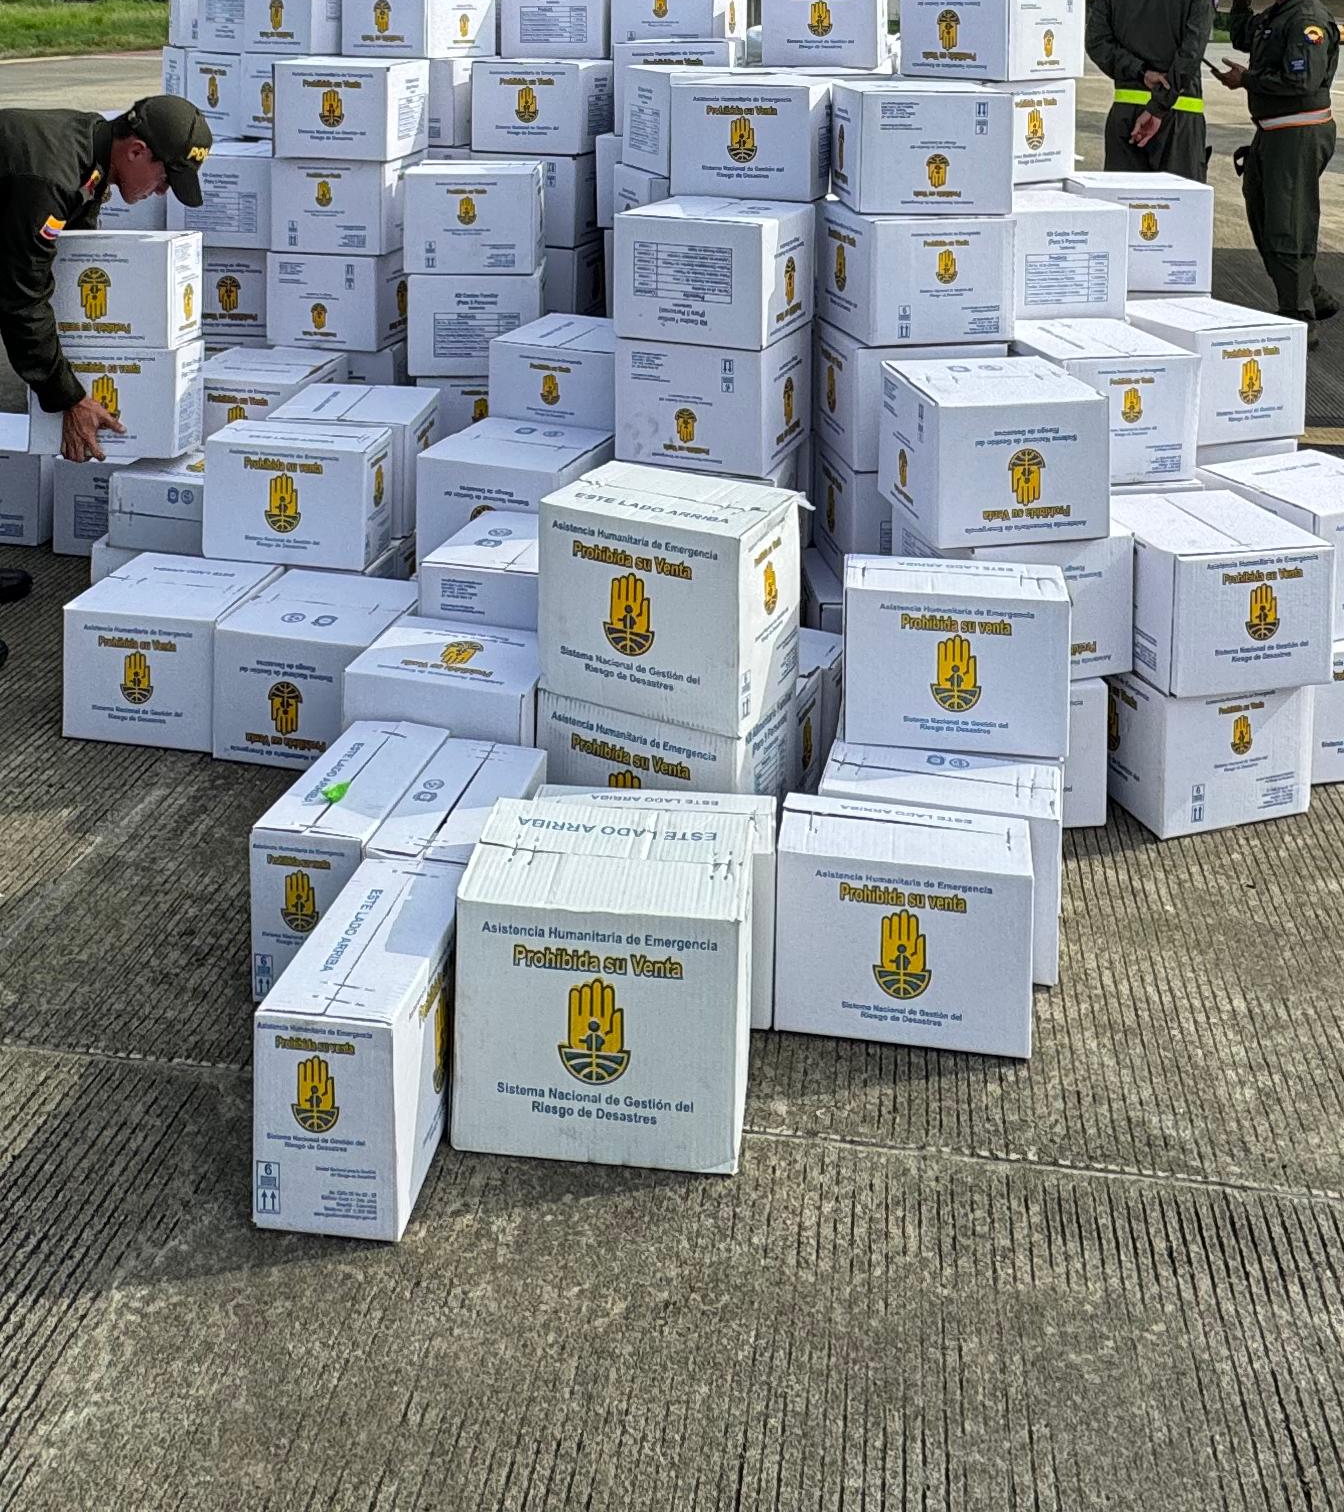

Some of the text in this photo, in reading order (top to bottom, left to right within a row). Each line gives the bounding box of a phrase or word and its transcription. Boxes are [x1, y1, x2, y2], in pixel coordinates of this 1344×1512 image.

[574, 492, 730, 525] ESTE LADO ARRIBA
[552, 520, 718, 560] Asistencia Humanitaria de Emergencia
[572, 540, 693, 580] Prohibida su Venta
[900, 614, 1012, 636] Prohibida su venta
[560, 645, 701, 686] Sistema Nacional de Gestión del
[584, 664, 674, 692] Riesgo de Desastres
[551, 711, 717, 762] Asistencia Humanitaria de Emergencia
[571, 733, 691, 780] Prohibida su Venta
[518, 815, 718, 841] ESTE LADO ARRIBA
[815, 870, 993, 895] Asistencia Humanitaria de Emergencia
[839, 882, 967, 913] Prohibida su venta
[481, 921, 718, 952] Asistencia Humanitaria de Emergencia
[512, 944, 684, 980] Prohibida su Venta
[497, 1081, 694, 1113] Sistema Nacional de Gestión del
[531, 1100, 657, 1126] Riesgo de Desastres
[264, 1163, 273, 1175] 6
